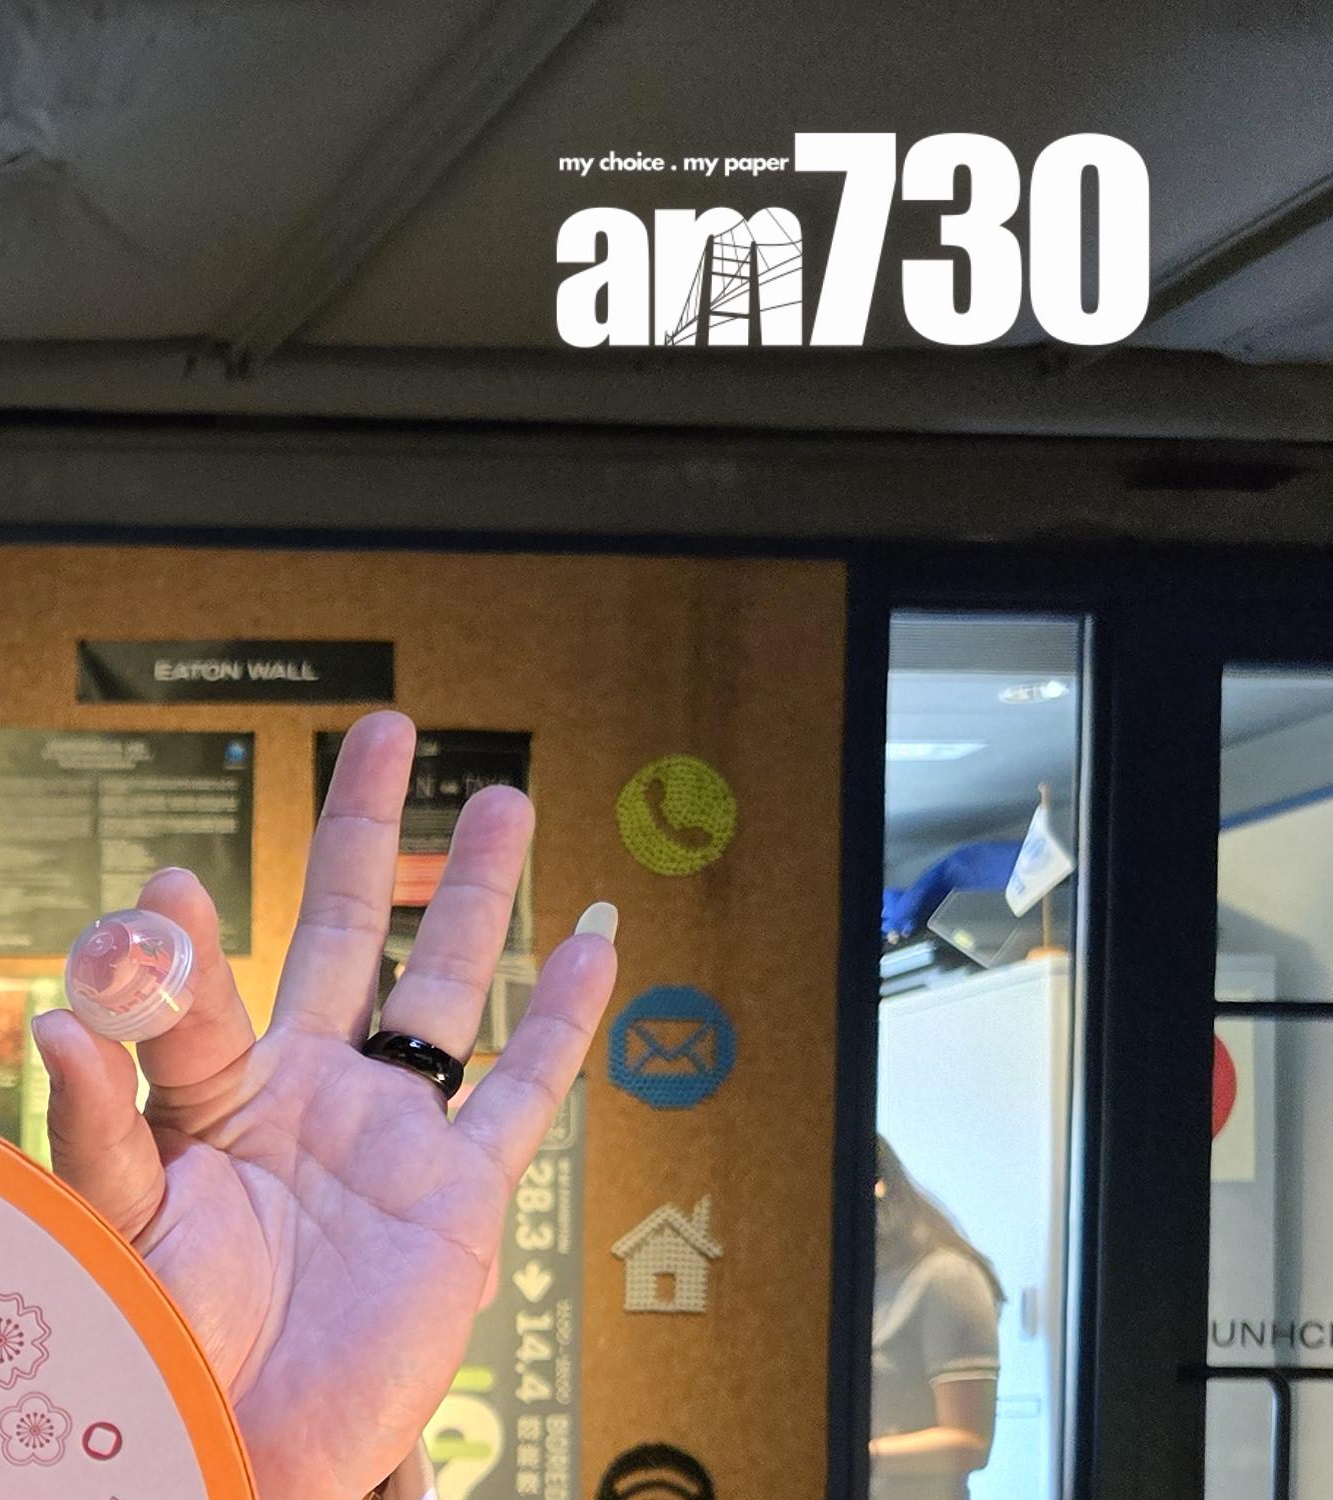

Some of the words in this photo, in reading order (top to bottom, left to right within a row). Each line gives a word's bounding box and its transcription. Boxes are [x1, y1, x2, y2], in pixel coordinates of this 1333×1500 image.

[153, 659, 242, 682] EATON
[246, 659, 319, 682] WALL
[1212, 1319, 1332, 1349] UNHC
